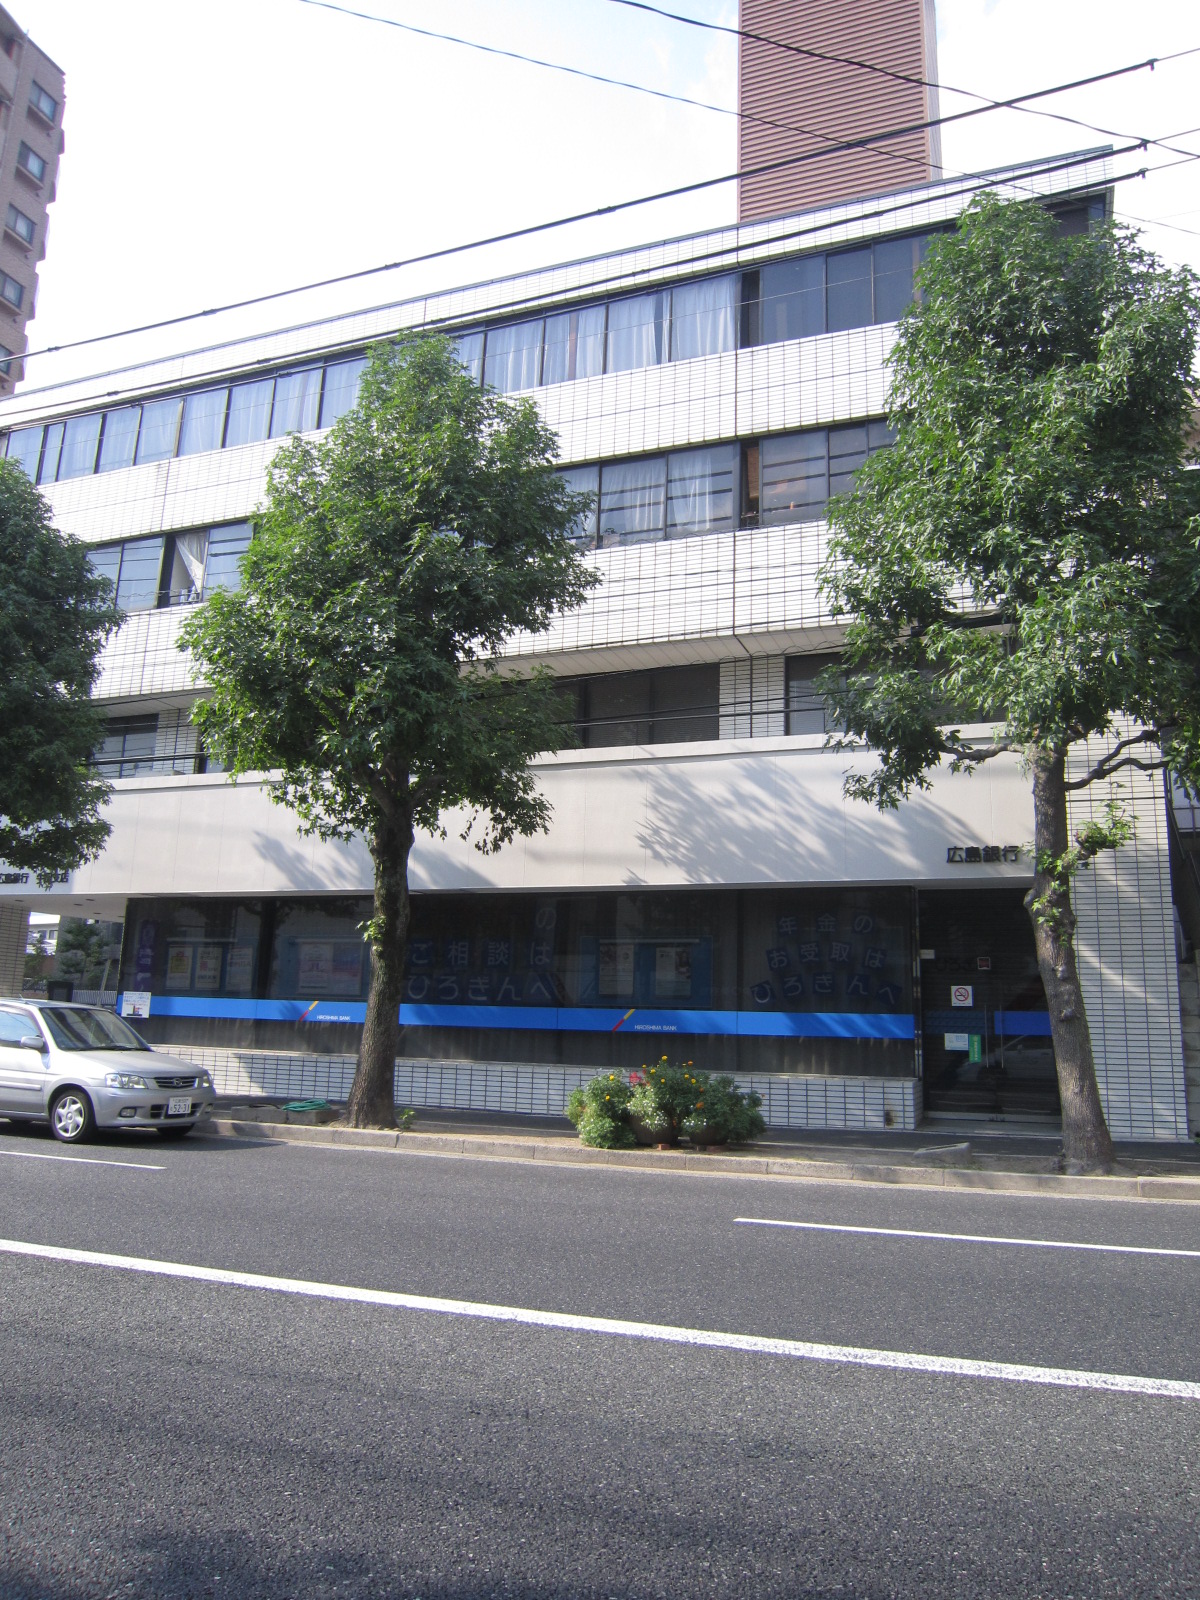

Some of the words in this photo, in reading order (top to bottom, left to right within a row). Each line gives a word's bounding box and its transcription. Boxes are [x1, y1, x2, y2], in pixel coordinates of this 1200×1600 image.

[946, 845, 1020, 863] 広島銀行
[778, 913, 873, 935] 年金の
[410, 942, 551, 966] ご相談は
[769, 942, 884, 968] お受取は
[407, 975, 552, 1001] ひろぎんへ
[173, 1104, 190, 1112] 52-31
